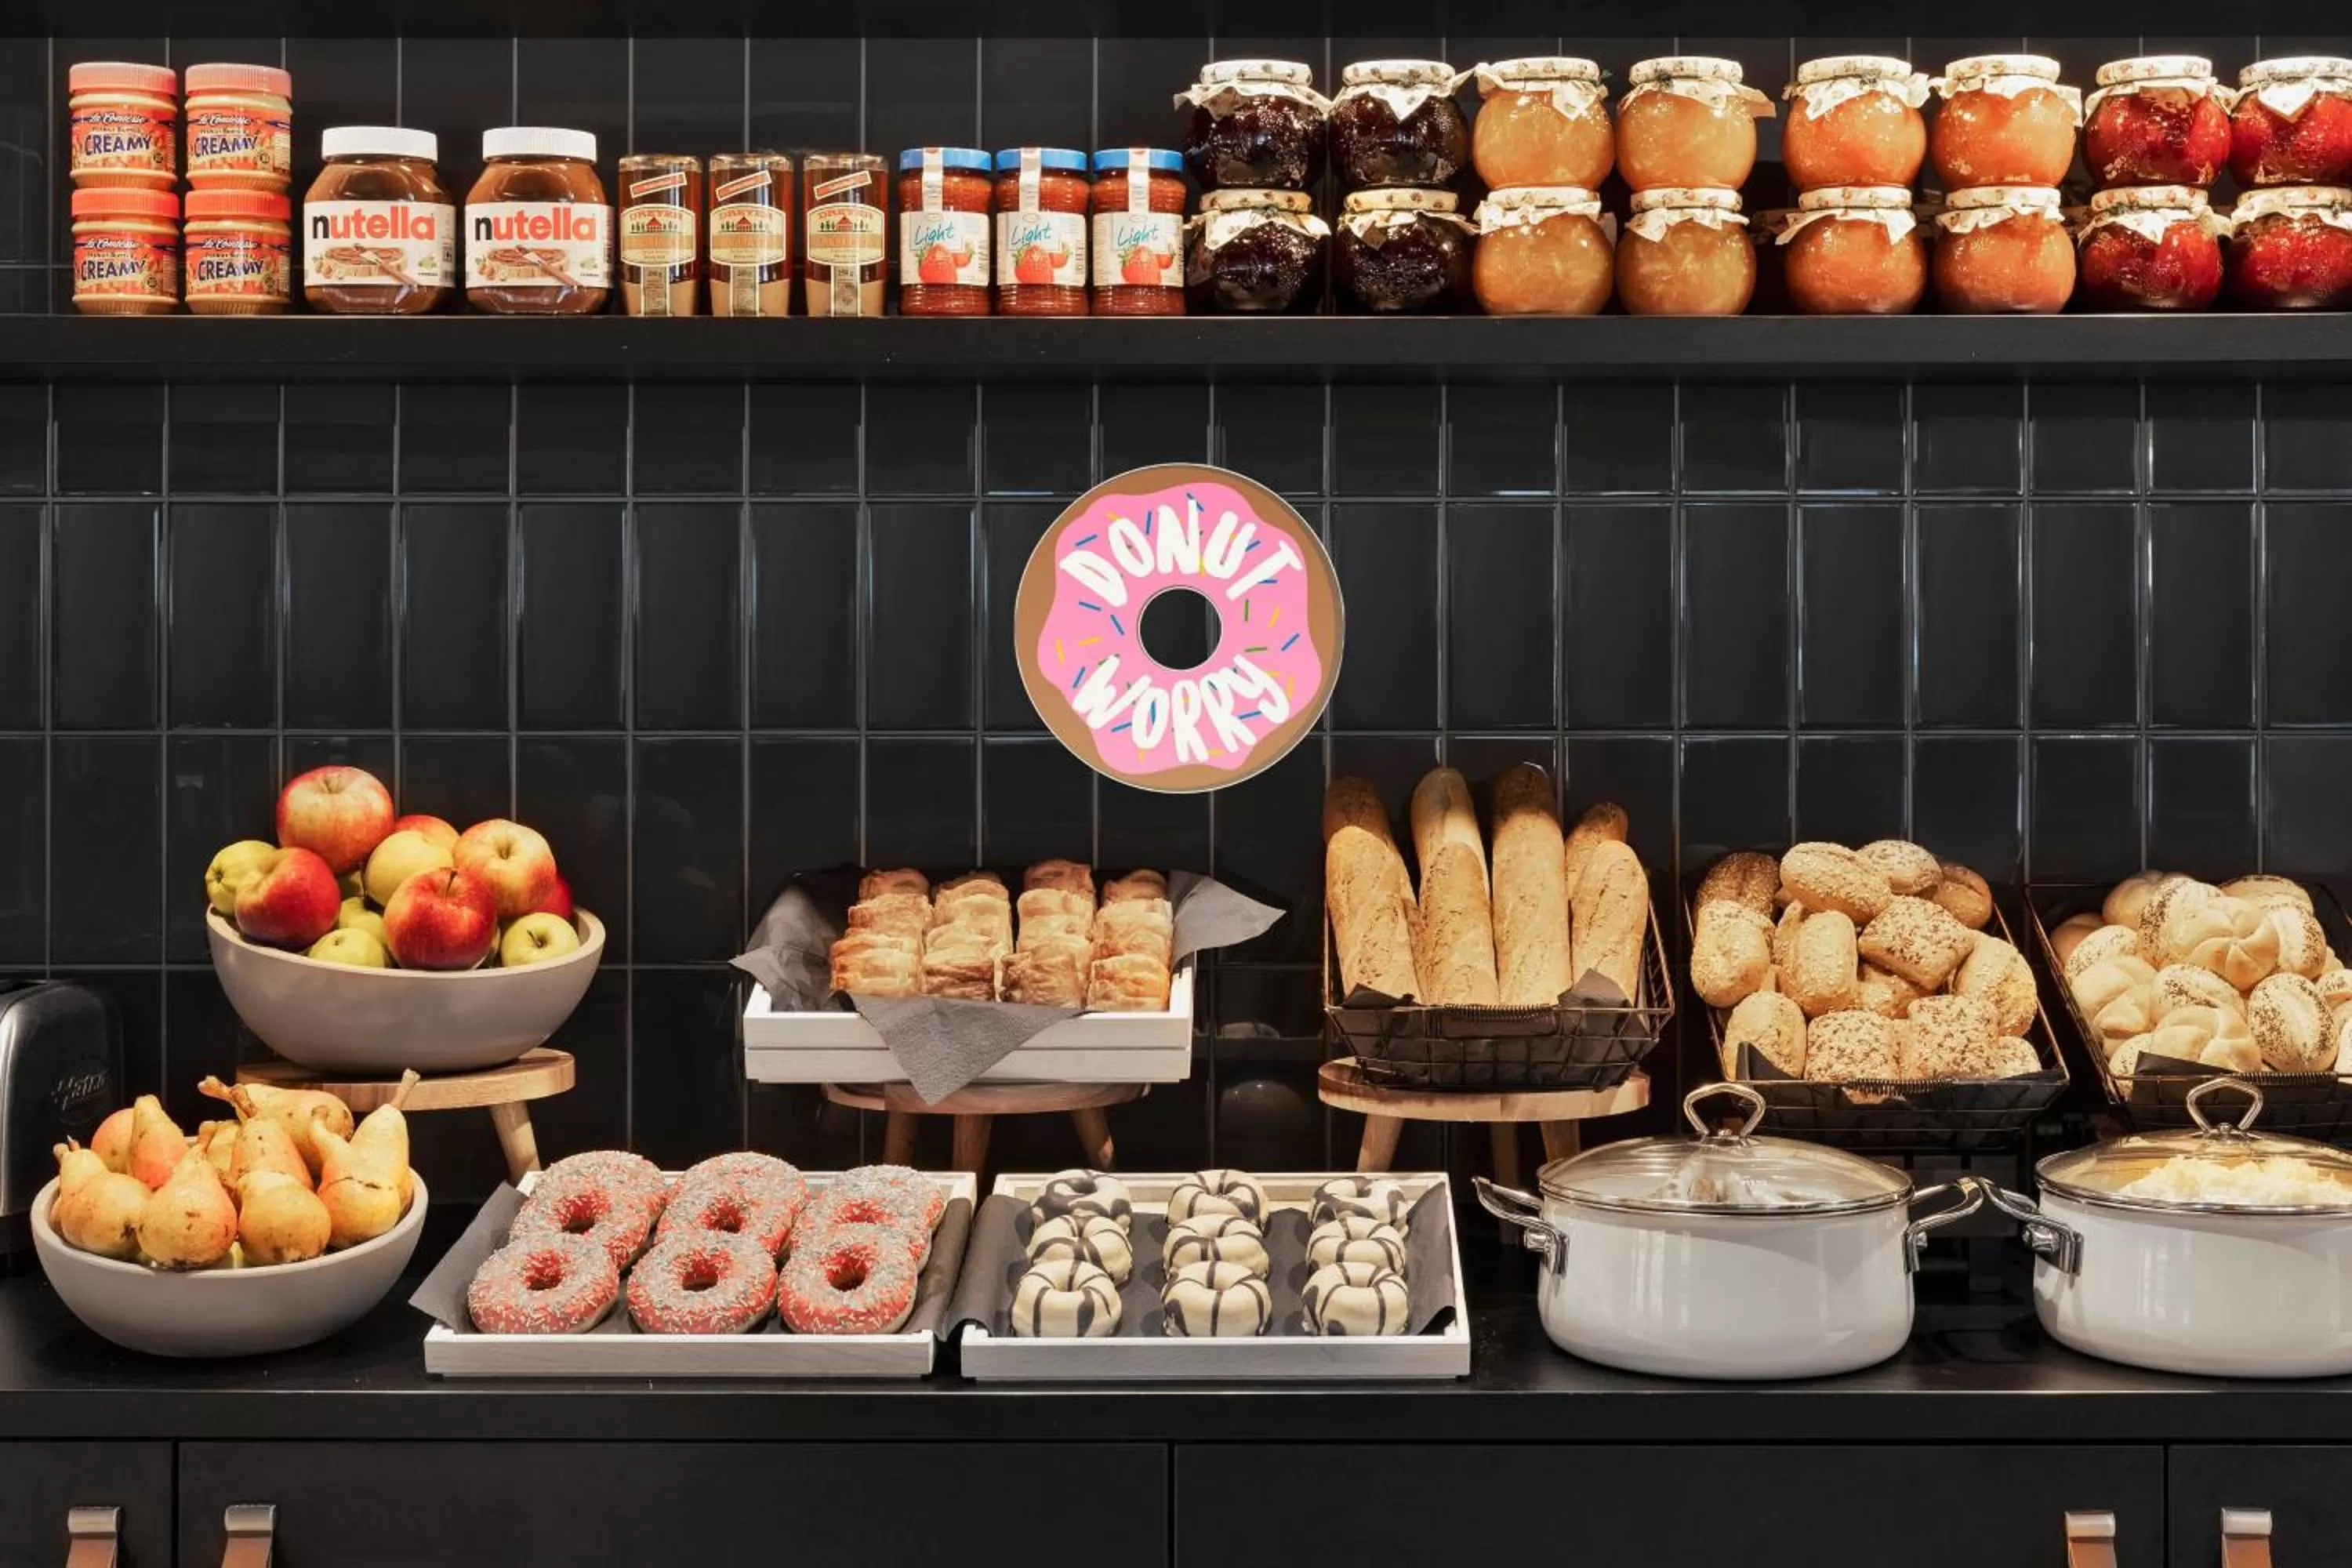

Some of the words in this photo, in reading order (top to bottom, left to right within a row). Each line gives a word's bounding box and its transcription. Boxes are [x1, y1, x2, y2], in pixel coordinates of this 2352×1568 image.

[85, 134, 151, 156] CREAMY
[194, 135, 257, 157] CREAMY
[313, 205, 436, 241] nutella
[475, 207, 597, 241] nutella
[915, 222, 953, 245] Light
[1011, 221, 1052, 245] Light
[1117, 223, 1159, 246] Light
[81, 260, 146, 281] CREAMY
[198, 260, 263, 281] CREAMY
[1059, 499, 1302, 607] DONUT
[1072, 654, 1290, 764] WORRY
